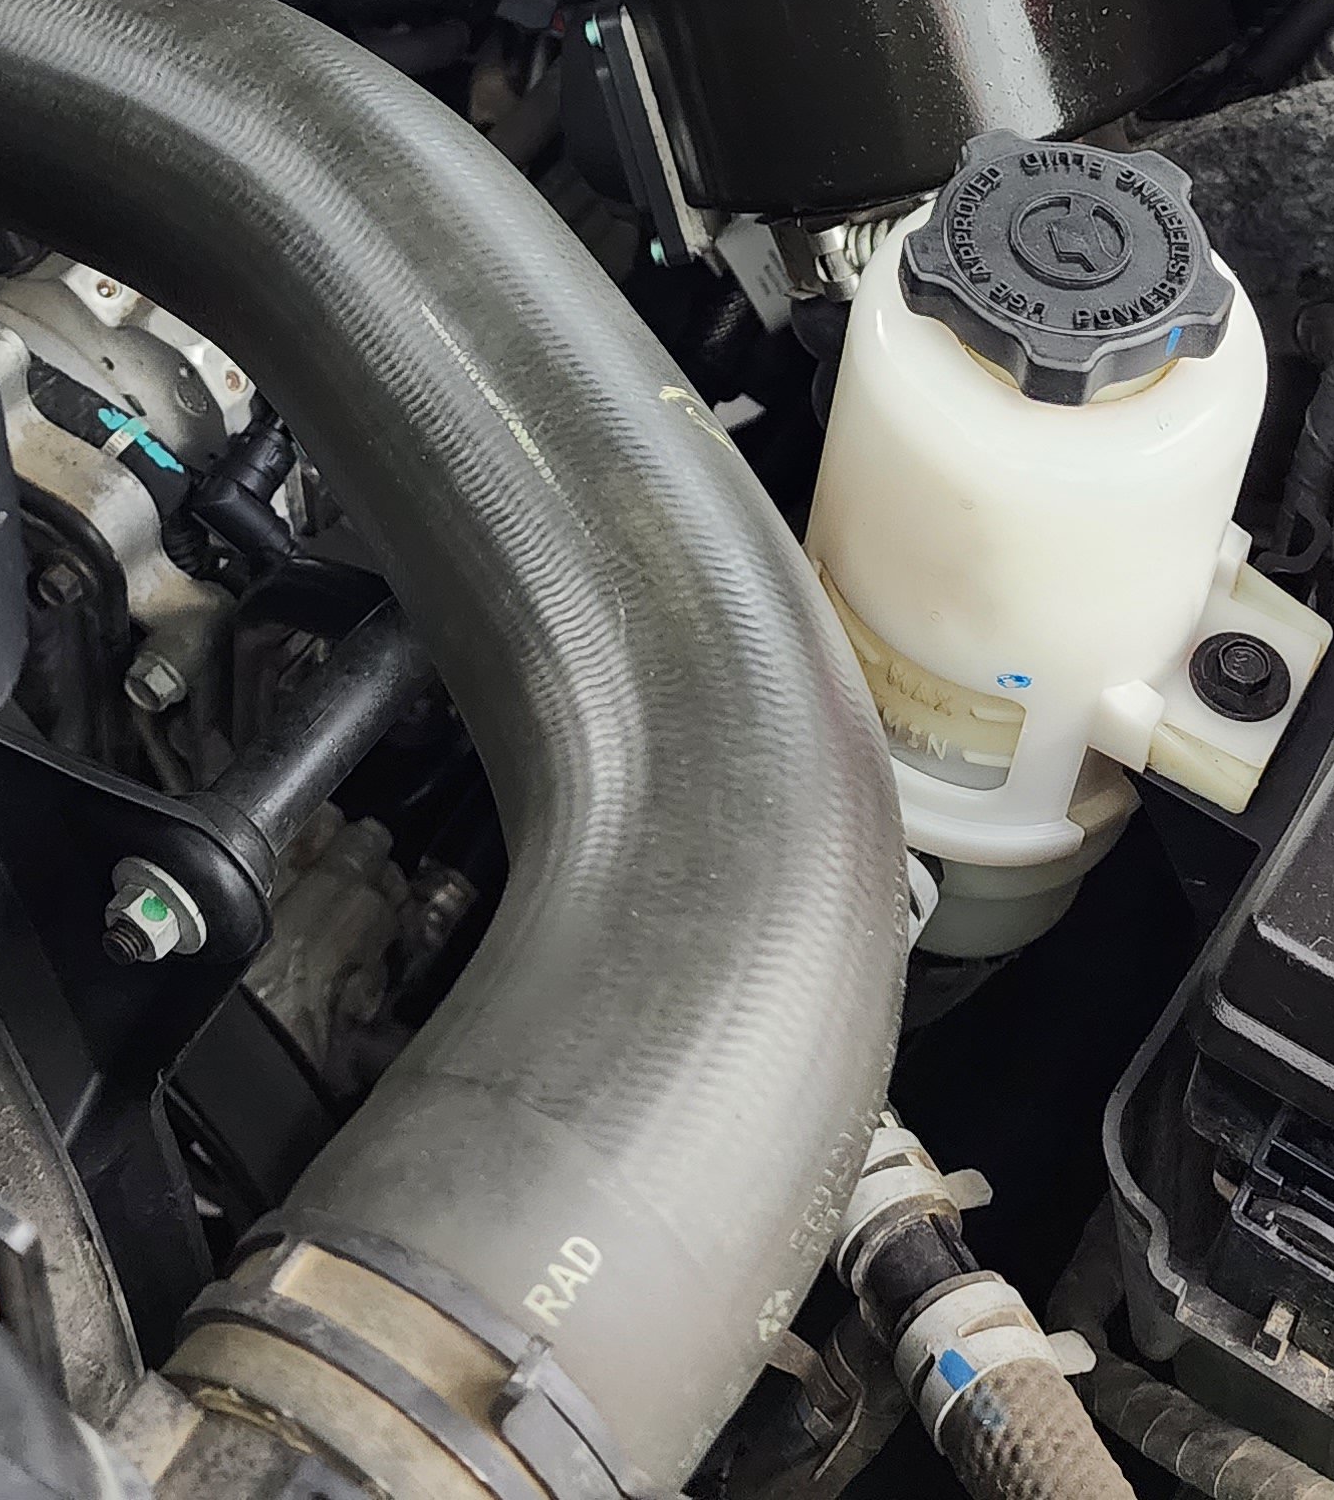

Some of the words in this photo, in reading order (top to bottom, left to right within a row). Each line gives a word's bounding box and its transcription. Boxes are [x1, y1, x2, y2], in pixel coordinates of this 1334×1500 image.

[1019, 150, 1107, 181] FLUID
[951, 164, 1005, 283] APPROVED
[1116, 166, 1192, 281] STEERING
[987, 280, 1048, 323] USE
[1072, 280, 1182, 330] POWER
[885, 659, 954, 719] MAX
[881, 705, 948, 762] MIN
[522, 1233, 606, 1330] RAD
